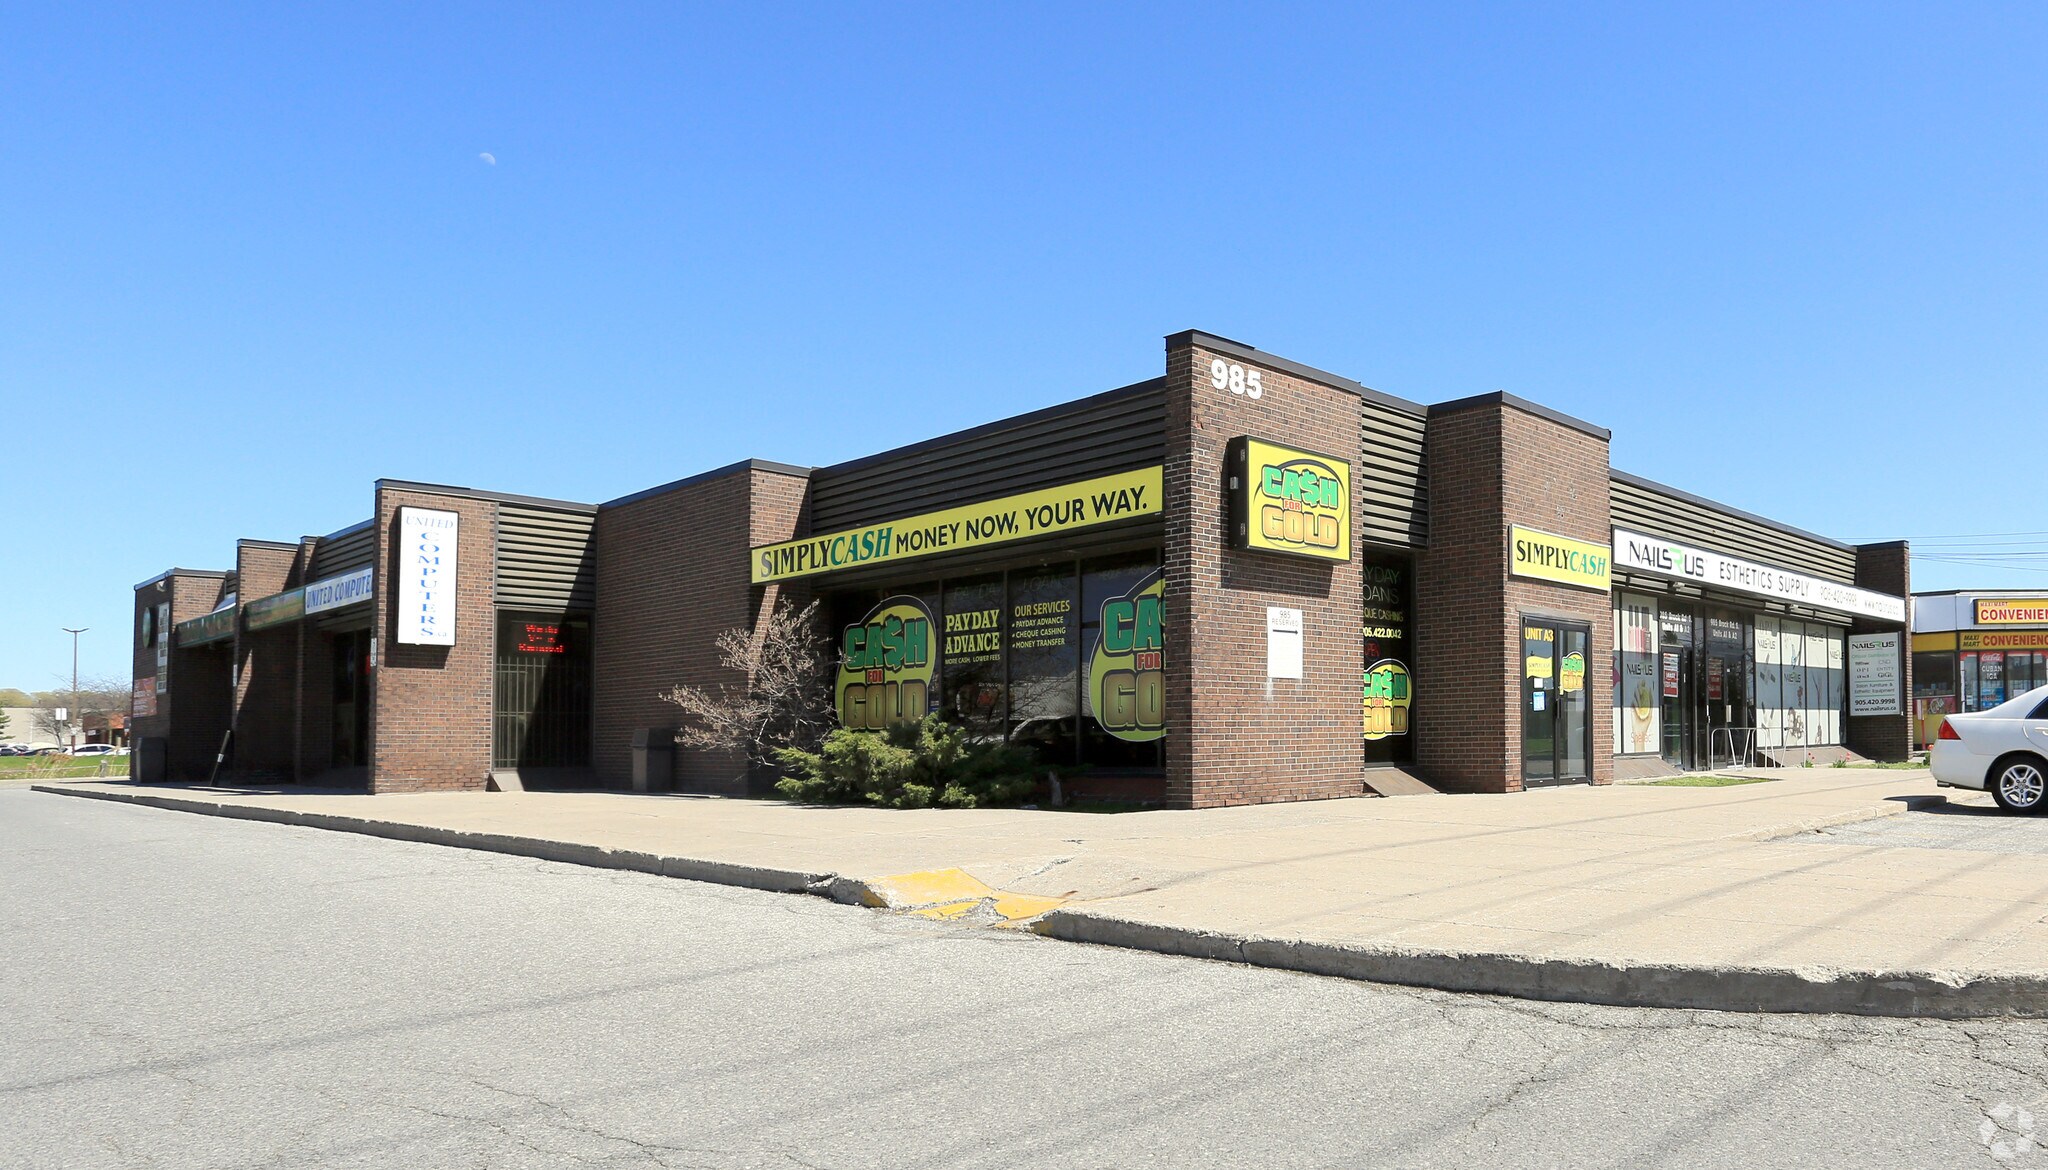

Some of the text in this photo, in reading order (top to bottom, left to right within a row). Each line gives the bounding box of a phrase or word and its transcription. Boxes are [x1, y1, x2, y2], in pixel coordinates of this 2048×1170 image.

[1211, 359, 1262, 400] 985
[1284, 500, 1301, 511] FOR
[406, 516, 453, 529] UNITED
[760, 485, 1147, 577] SIMPLYCASH MONEY NOW, YOUR WAY.
[1262, 504, 1338, 548] GOLD
[1516, 540, 1606, 577] SIMPLYCASH
[418, 532, 440, 636] COMPUTERS
[1720, 561, 1773, 590] ESTHETICS
[1779, 575, 1809, 597] SUPPLY
[307, 574, 372, 608] UNITED COMPUTE
[1014, 600, 1070, 617] OUR SERVICES
[1280, 610, 1291, 619] 985
[1378, 609, 1404, 622] CASHING
[945, 609, 999, 632] PAYDAY
[1016, 616, 1063, 628] PAYDAY ADVANCE
[1102, 595, 1166, 655] CA
[1016, 627, 1066, 638] CHEQUE CASHING
[1525, 627, 1554, 642] UNIT A3
[1712, 629, 1722, 637] Units
[945, 632, 999, 654] ADVANCE
[1015, 638, 1065, 649] MONEY TRANSFER
[944, 657, 957, 665] MORE
[1136, 652, 1161, 669] FOR
[867, 669, 883, 683] FOR
[844, 681, 927, 731] GOLD
[1372, 698, 1384, 707] FOR
[1364, 705, 1407, 734] GOLD
